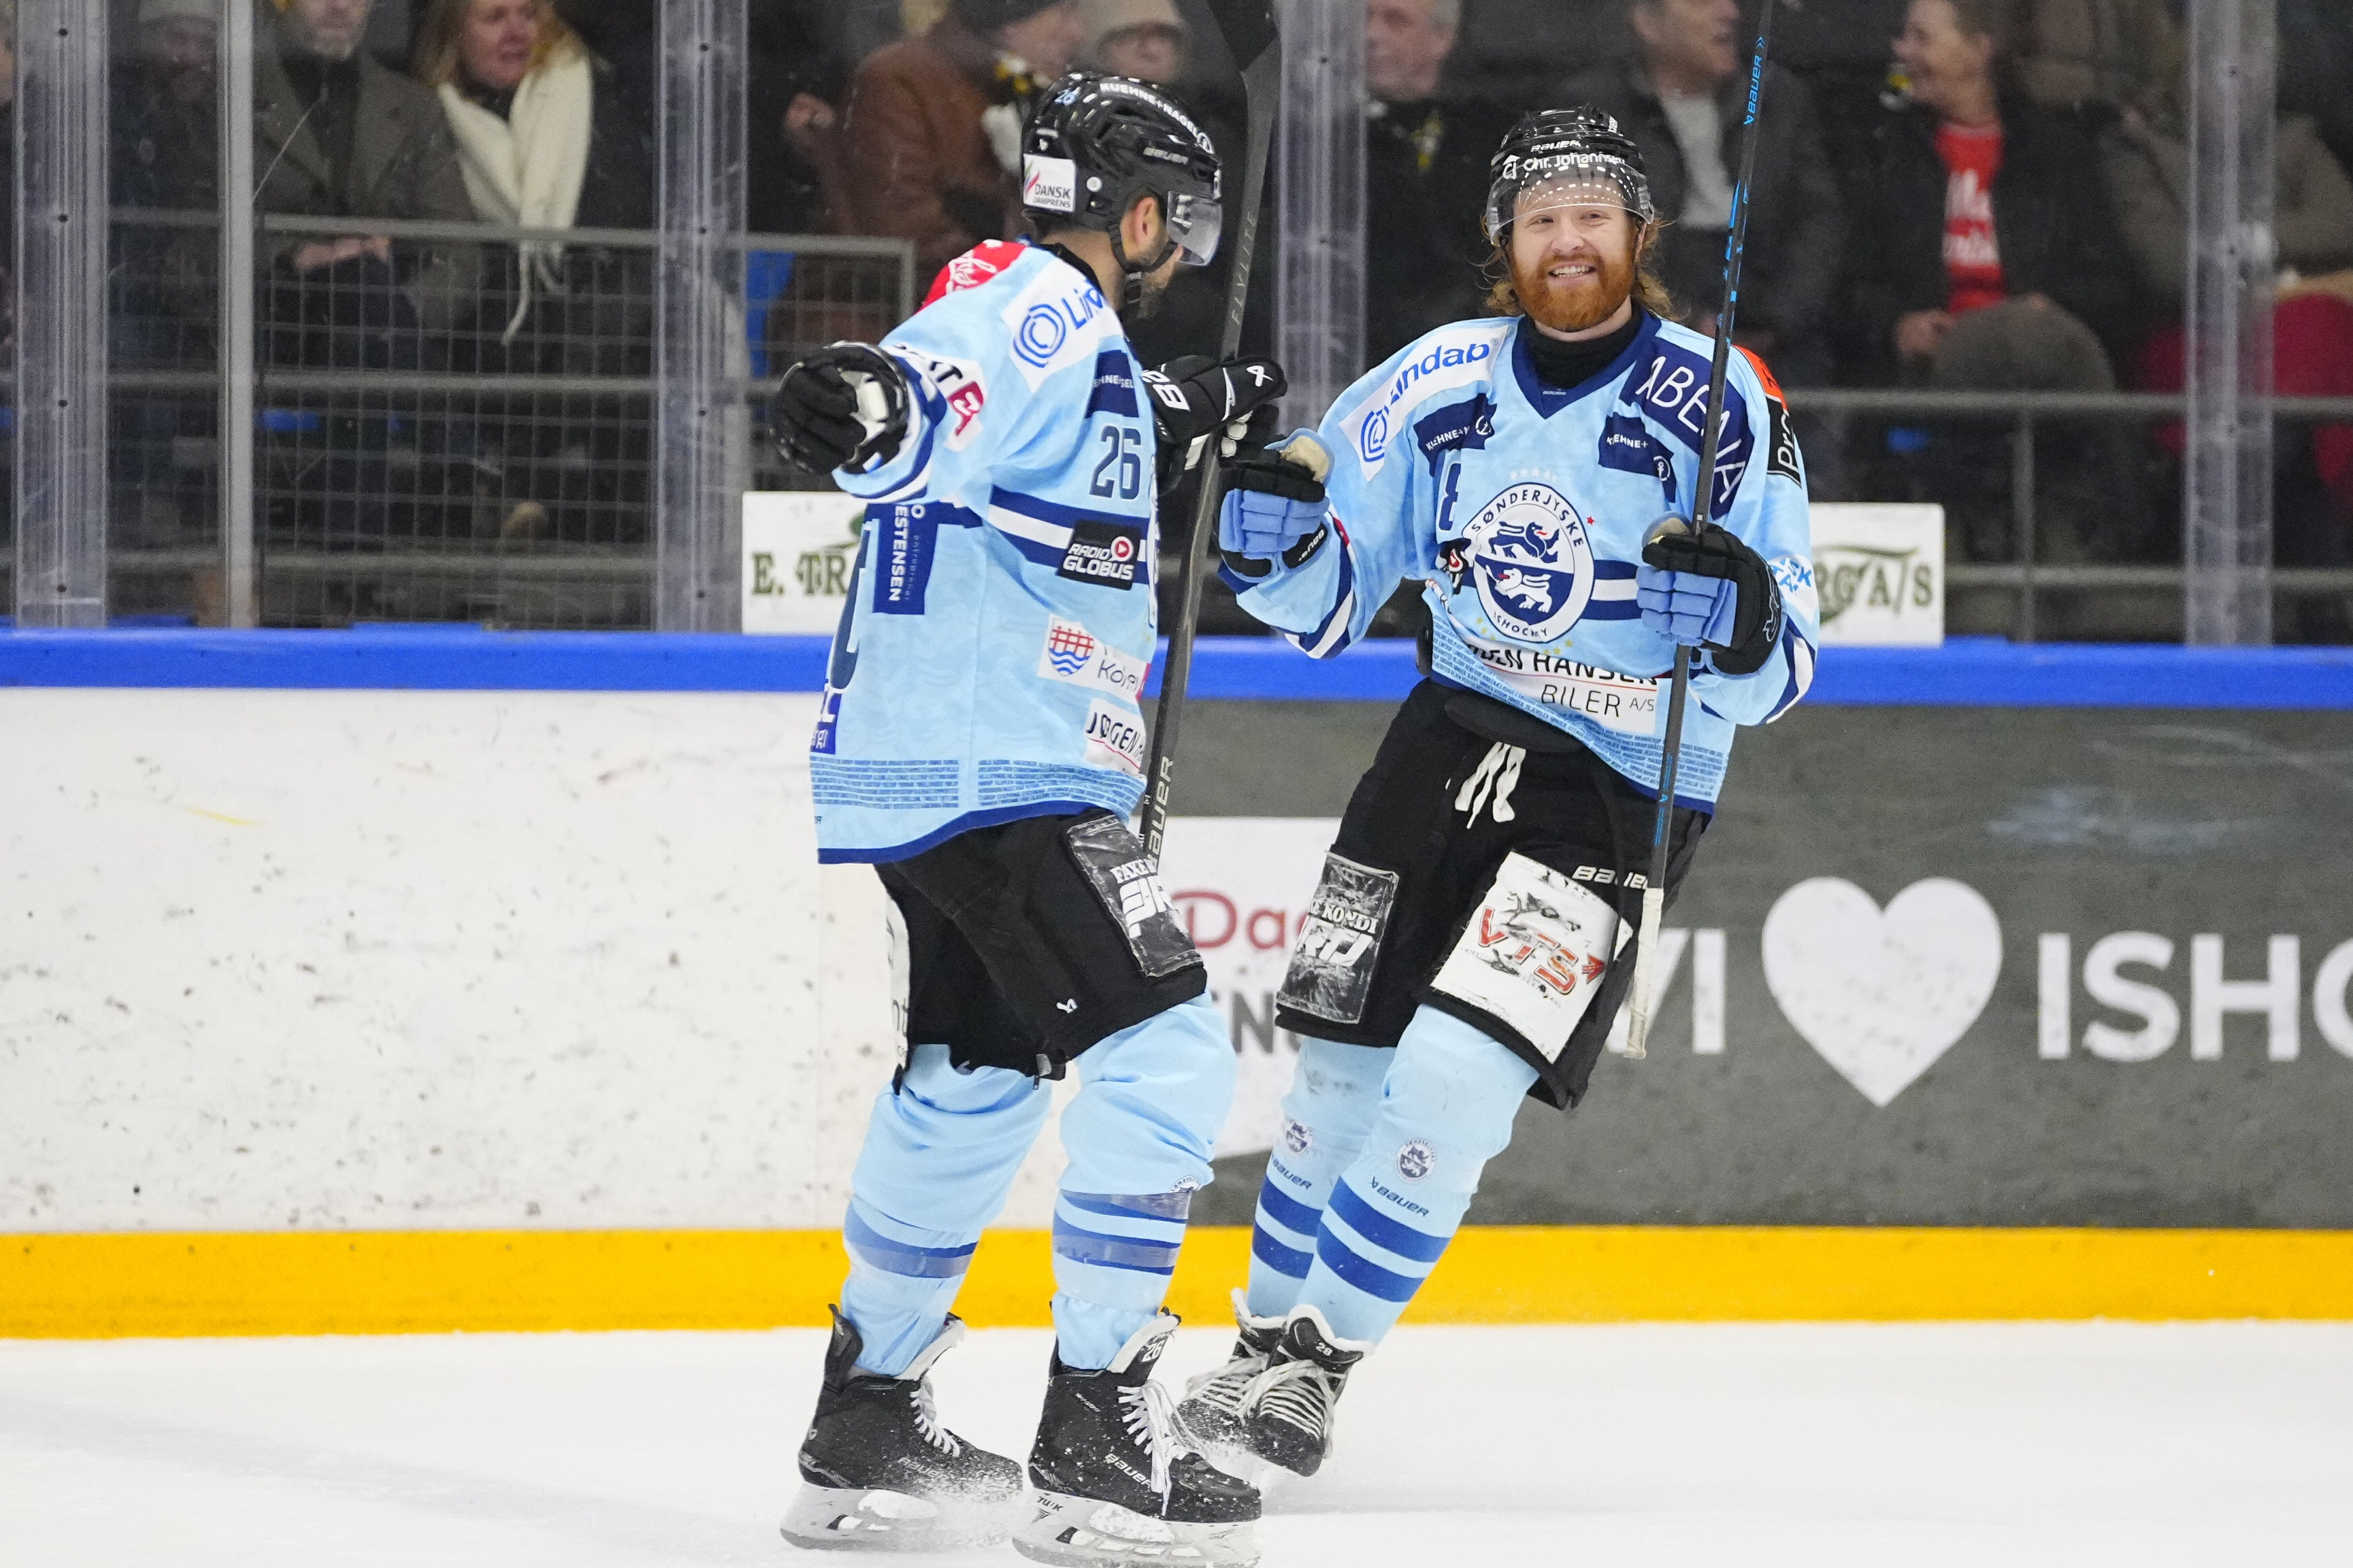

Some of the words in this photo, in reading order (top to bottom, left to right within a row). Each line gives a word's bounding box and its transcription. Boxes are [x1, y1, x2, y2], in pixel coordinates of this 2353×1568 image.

[1747, 54, 1762, 114] BAUER
[1034, 183, 1072, 199] DANSK
[1089, 424, 1142, 501] 26
[1472, 490, 1584, 547] SØNDERJYSKE
[889, 505, 909, 601] ESTENSEN
[1063, 561, 1134, 580] GLOBUS
[1068, 543, 1110, 561] RADIO
[1541, 683, 1620, 718] BILER
[1629, 697, 1656, 712] A/S
[1478, 905, 1579, 995] VTS
[1379, 1186, 1430, 1218] BAUER
